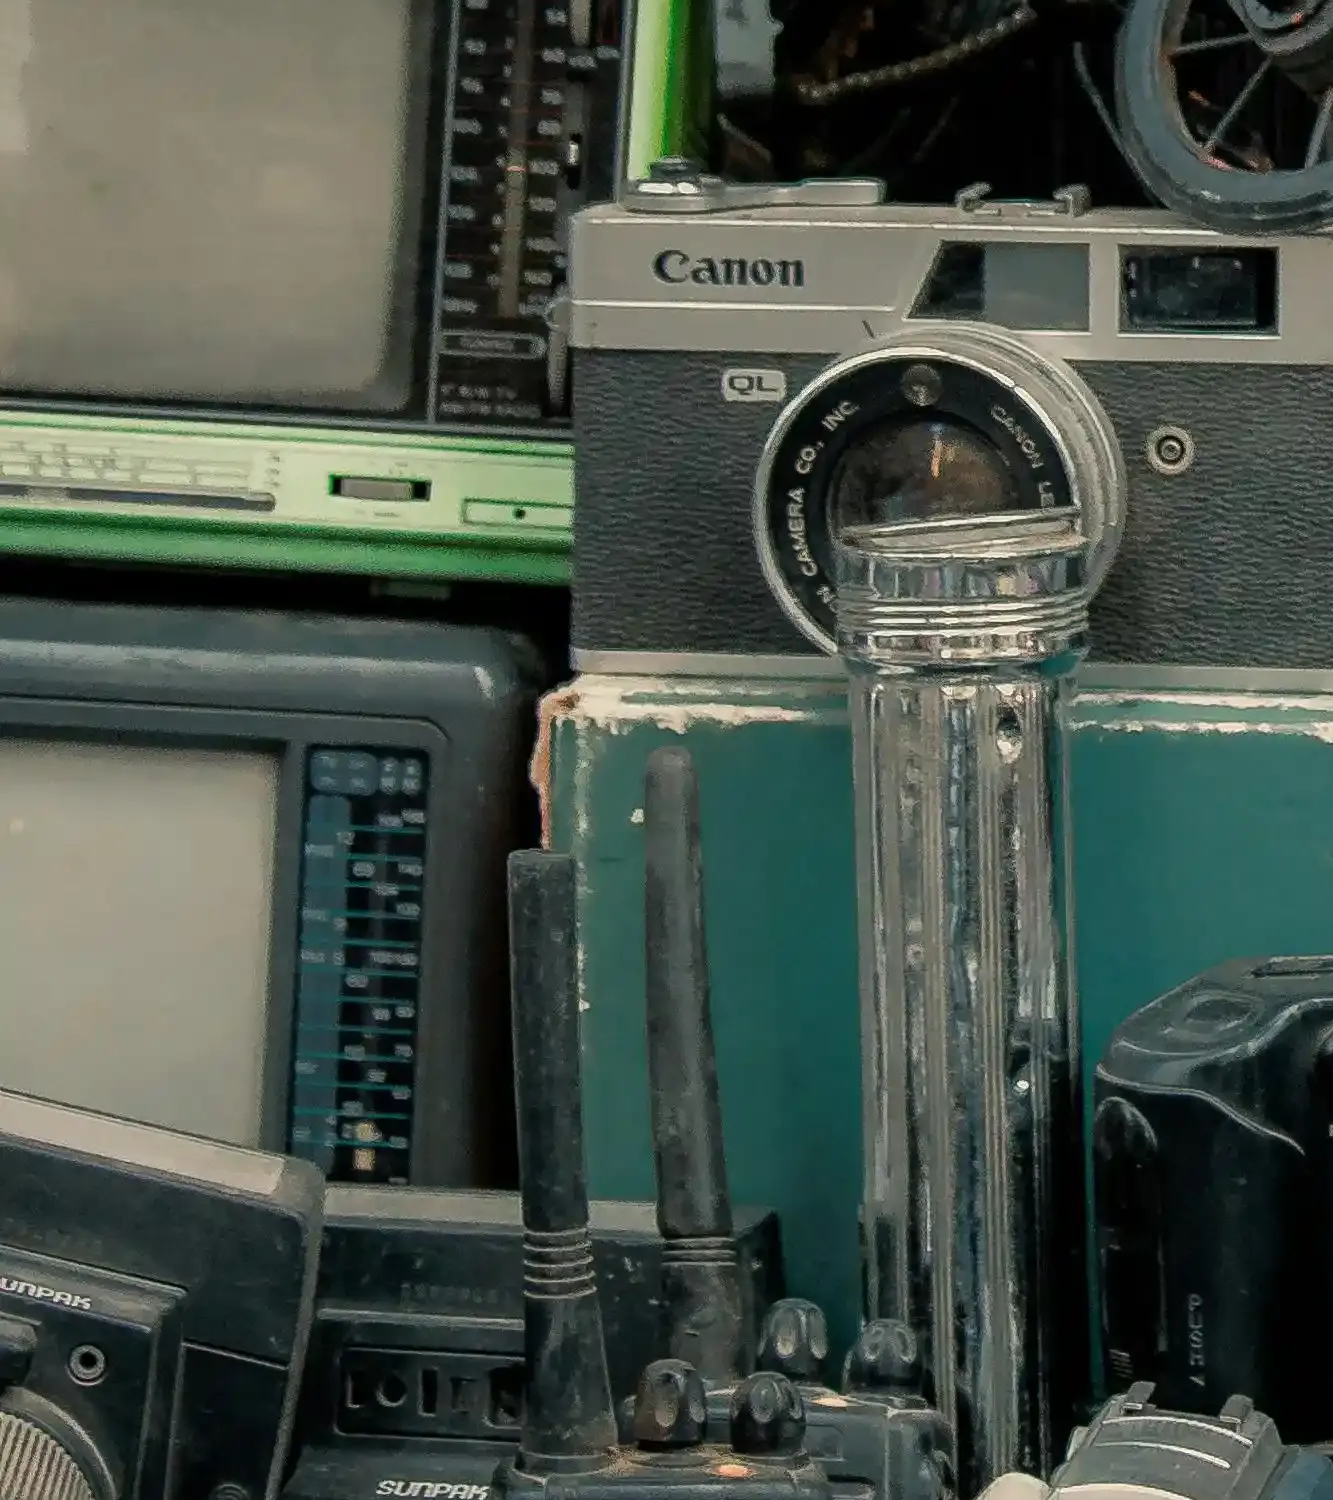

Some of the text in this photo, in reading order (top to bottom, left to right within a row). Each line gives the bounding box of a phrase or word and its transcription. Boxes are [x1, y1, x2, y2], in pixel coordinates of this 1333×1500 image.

[653, 248, 806, 289] Canon
[727, 372, 781, 398] QL
[990, 403, 1046, 470] CANON
[788, 486, 818, 577] CAMERA
[0, 1276, 92, 1311] UNPAK
